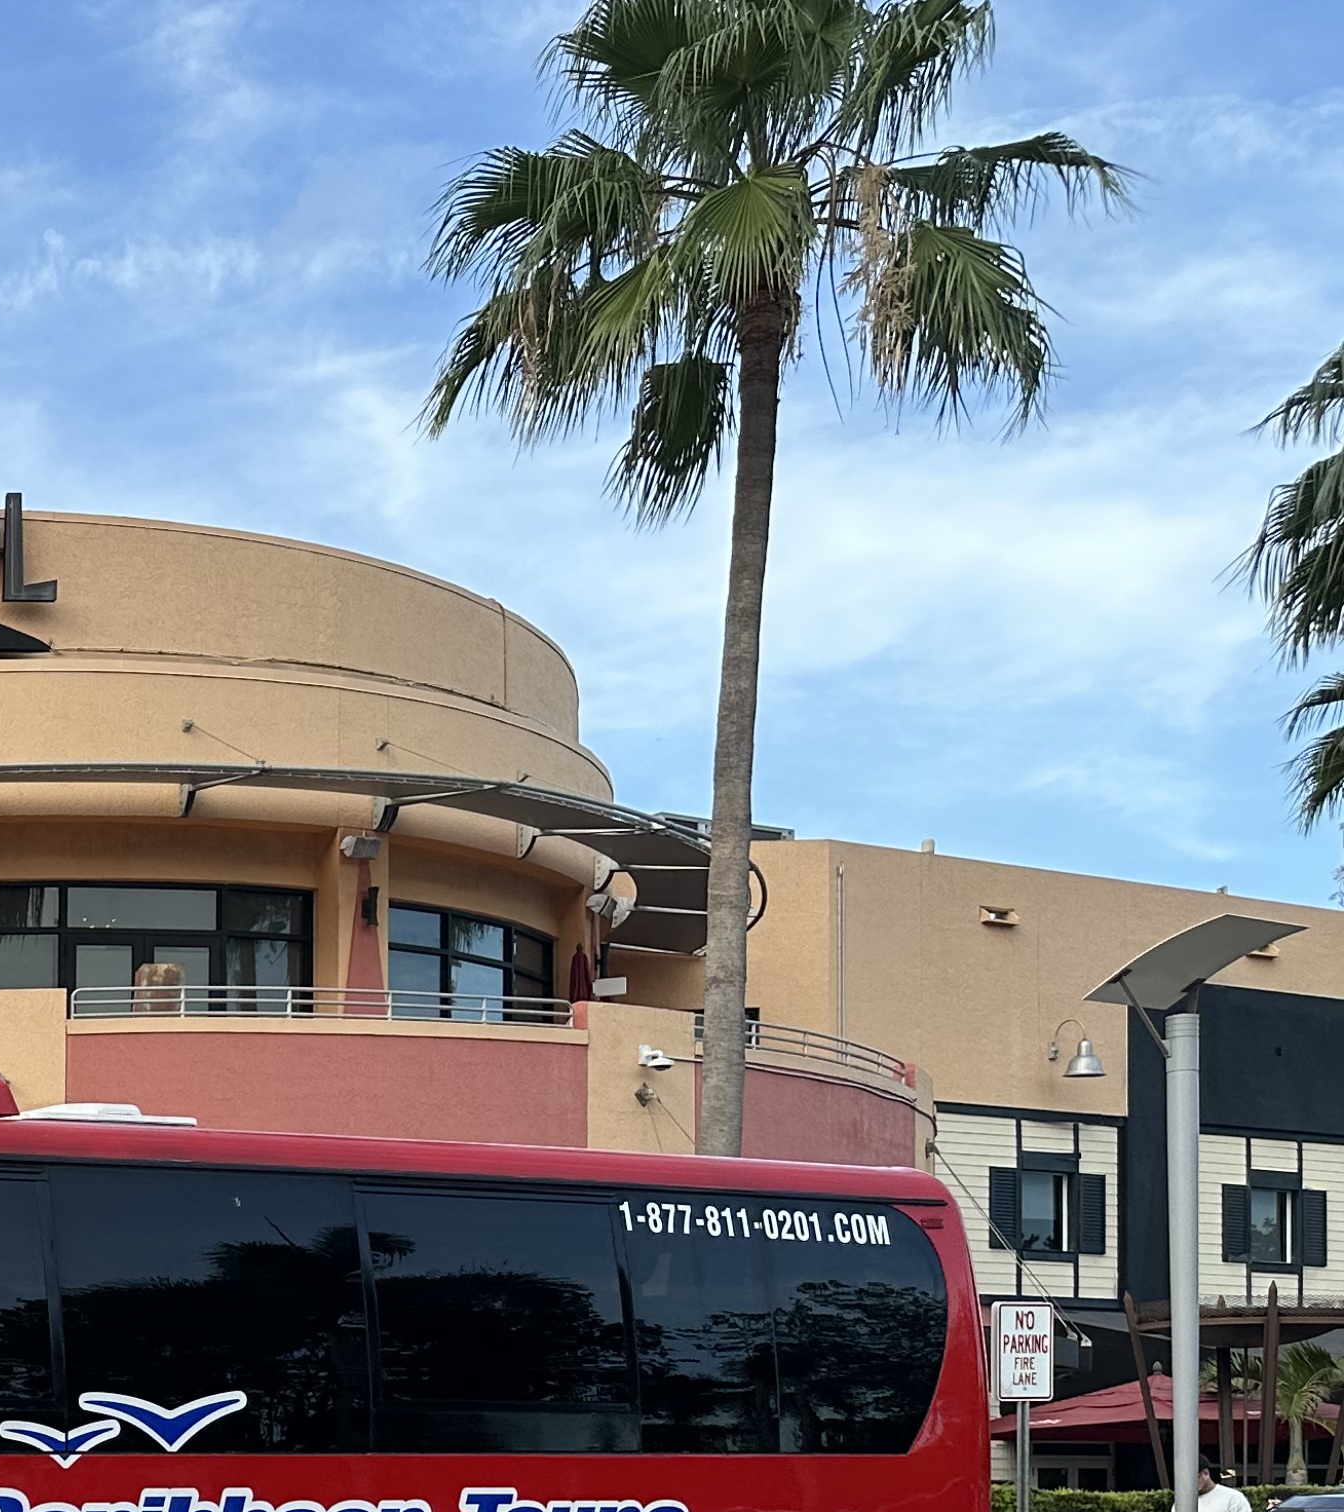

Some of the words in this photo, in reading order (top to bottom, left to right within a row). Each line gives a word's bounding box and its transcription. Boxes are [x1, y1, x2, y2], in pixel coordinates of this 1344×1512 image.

[619, 1201, 891, 1245] 1-877-811-0201.COM
[1015, 1311, 1035, 1330] NO
[1003, 1334, 1048, 1354] PARKING
[1014, 1357, 1035, 1370] FIRE
[1012, 1372, 1037, 1386] LANE
